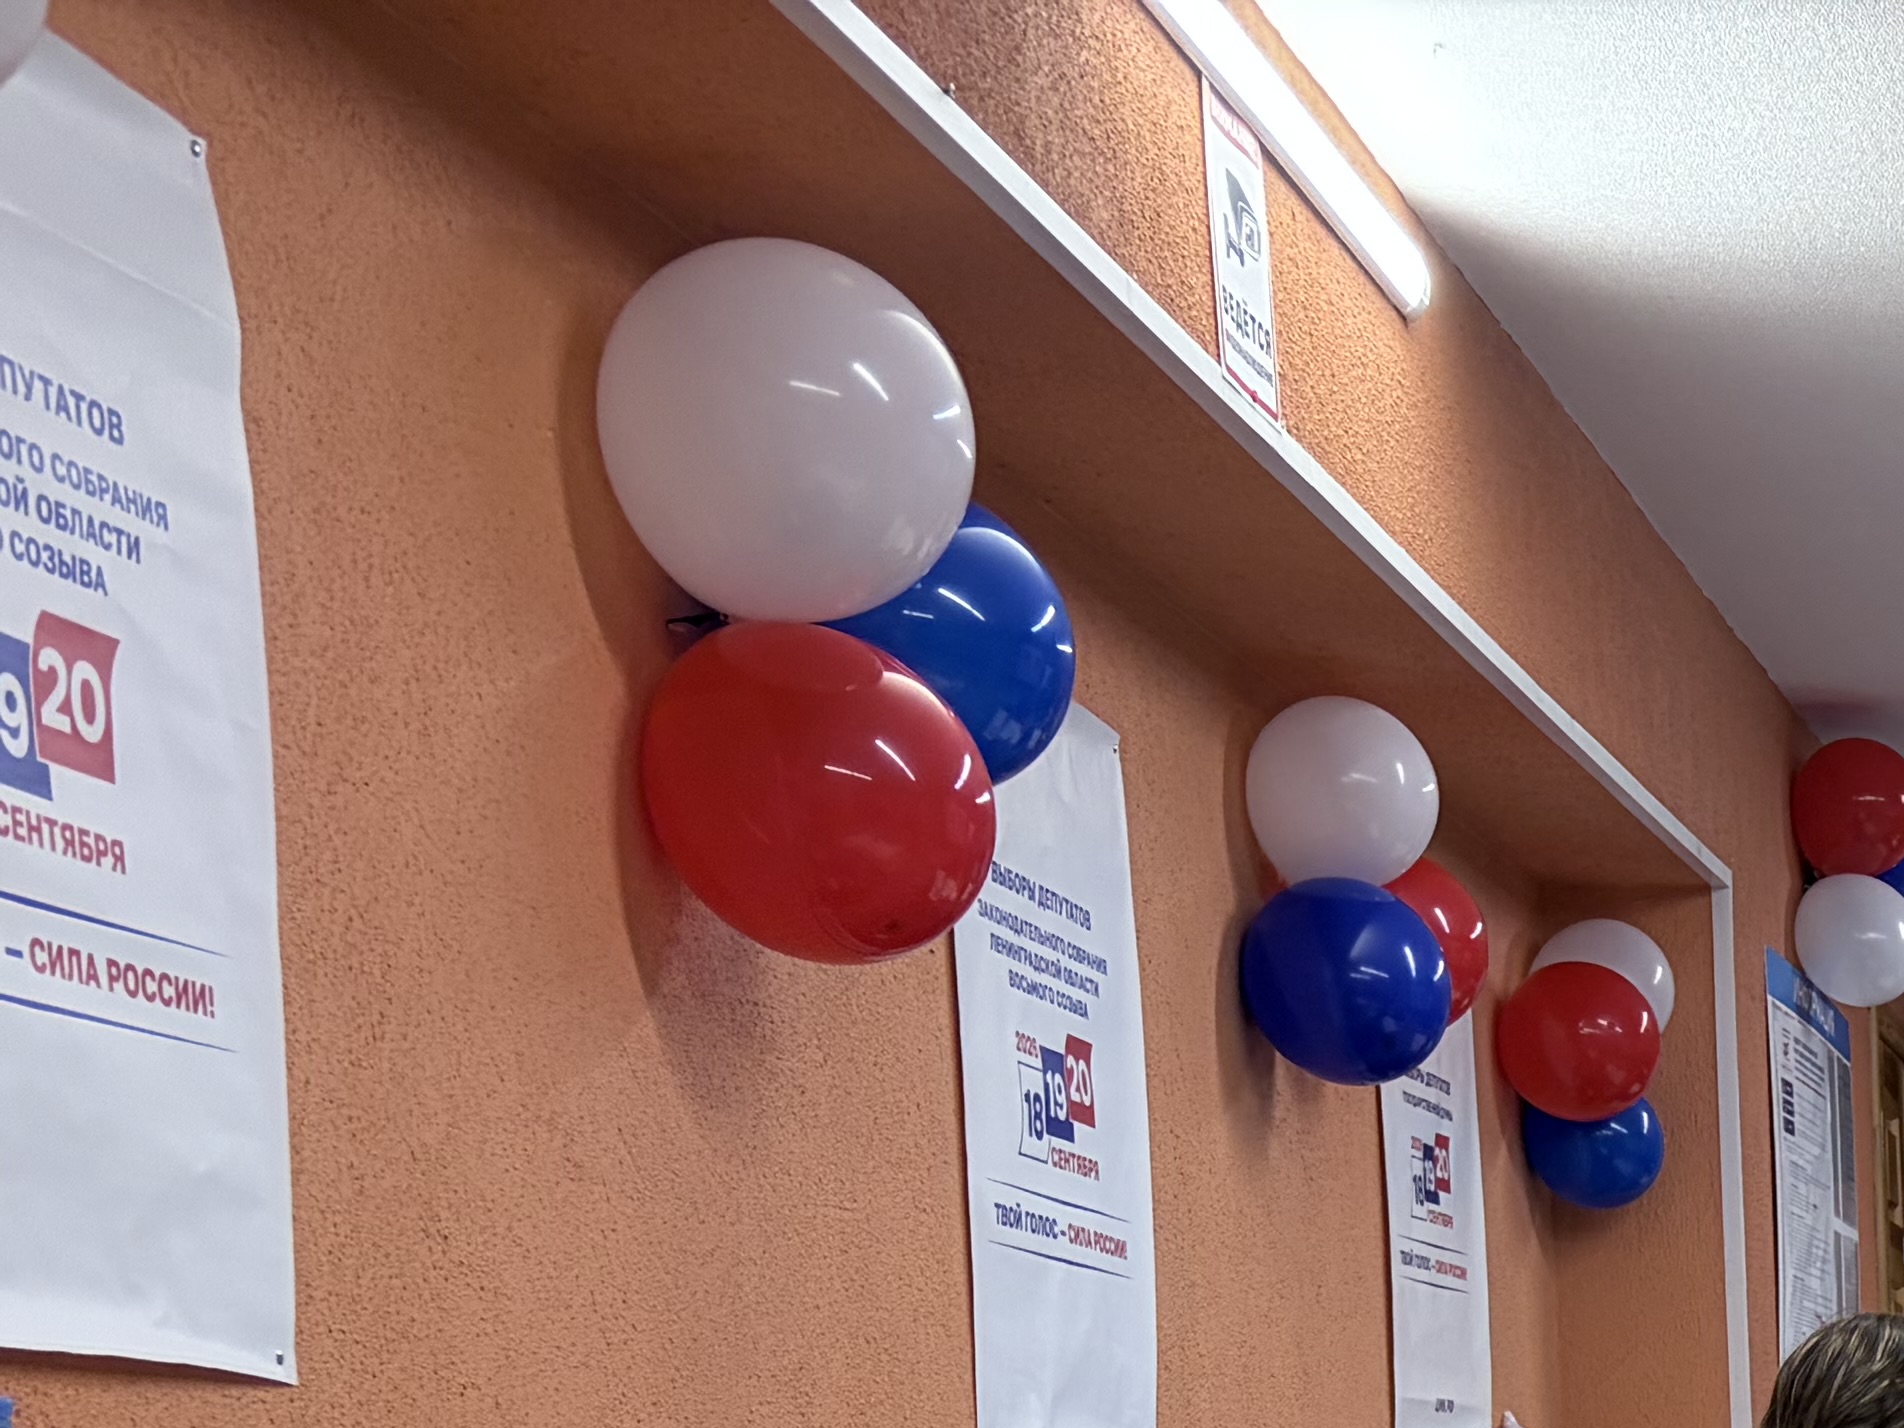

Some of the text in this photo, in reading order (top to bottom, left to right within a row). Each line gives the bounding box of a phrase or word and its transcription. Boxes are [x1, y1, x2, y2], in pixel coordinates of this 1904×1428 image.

[0, 354, 124, 446] ПУТАТОВ
[50, 452, 169, 532] СОБРАНИЯ
[9, 530, 108, 597] СОЗЫВА
[36, 494, 141, 565] ОБЛАСТИ
[38, 646, 106, 744] 20
[991, 860, 1091, 931] ВЫБОРЫ ДЕПУТАТОВ
[978, 898, 1107, 976] ЗАКОНОДАТЕЛЬНОГО СОБРАНИЯ
[990, 932, 1062, 981] ЛЕНИНГРАДСКОЙ
[29, 937, 101, 989] СИЛА
[106, 957, 216, 1019] РОССИИ!
[1024, 1059, 1092, 1141] 18 19 20
[1051, 1146, 1100, 1182] СЕНТЯБРЯ
[1434, 1147, 1449, 1180] 20
[994, 1202, 1022, 1229] ТВОЙ
[1024, 1211, 1058, 1240] ГОЛОС
[1068, 1222, 1093, 1249] СИЛА
